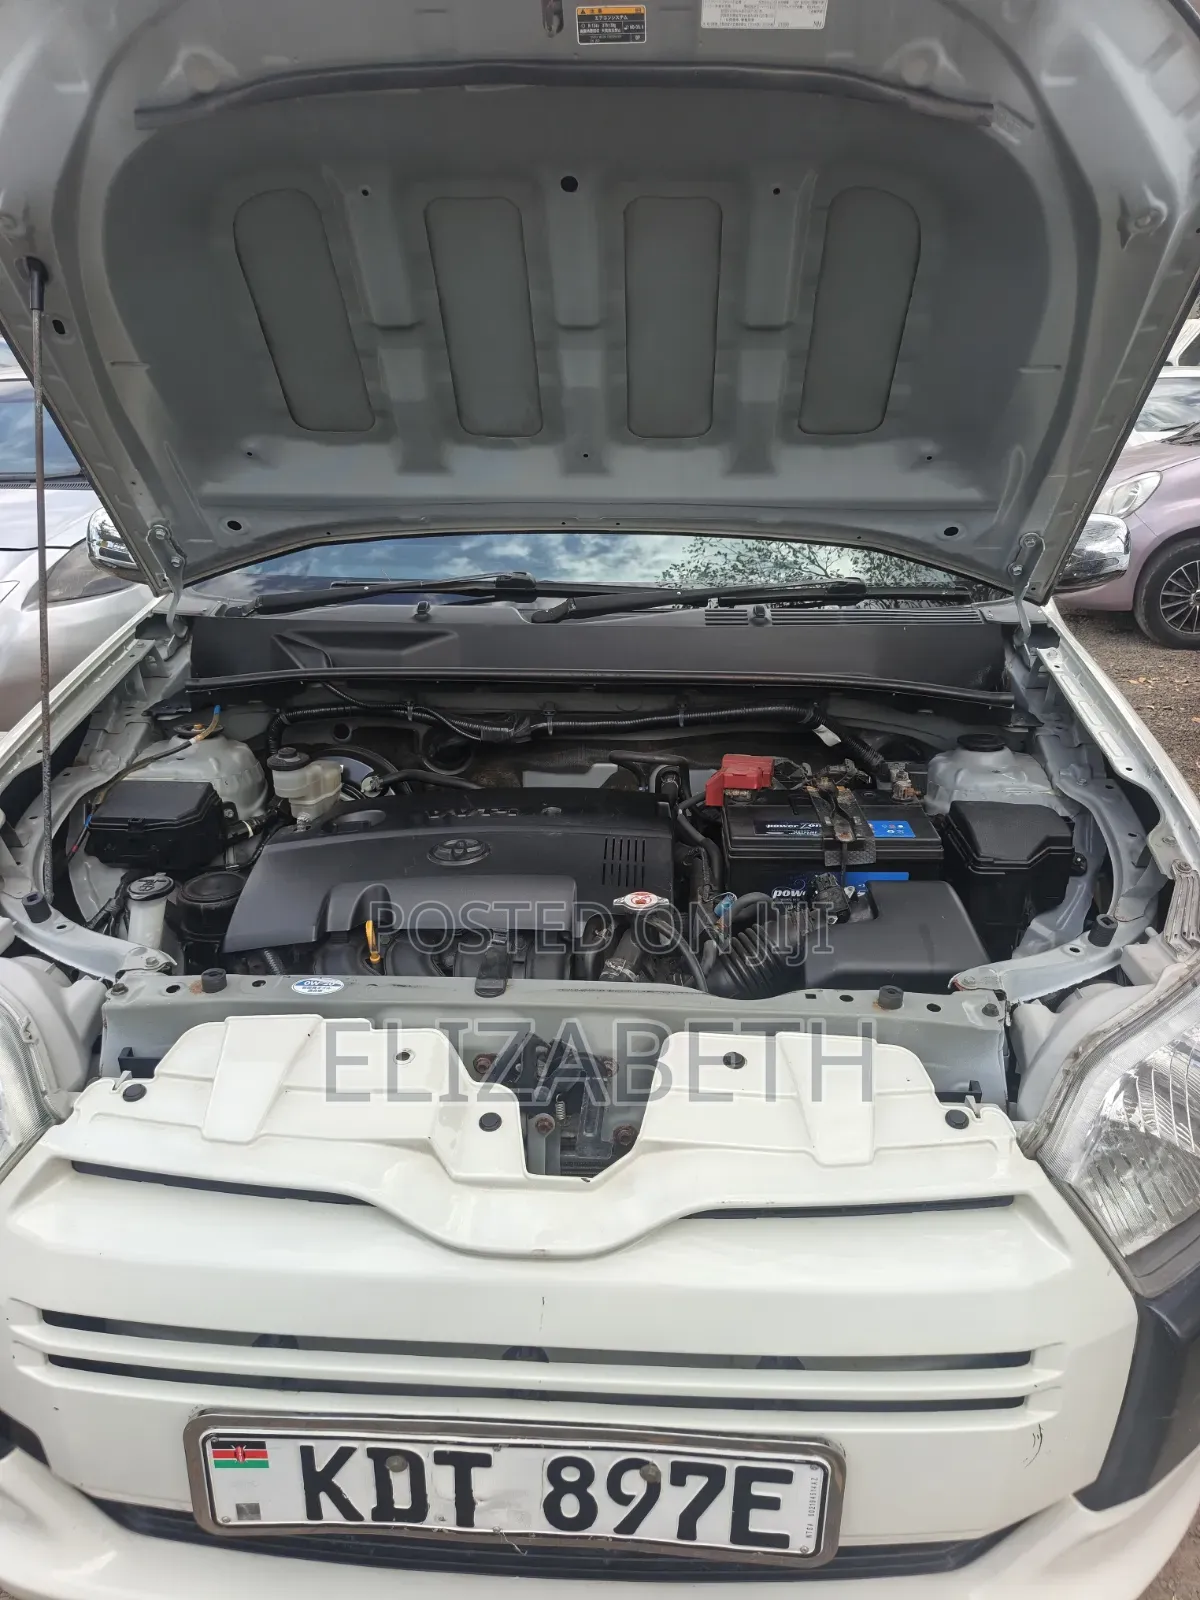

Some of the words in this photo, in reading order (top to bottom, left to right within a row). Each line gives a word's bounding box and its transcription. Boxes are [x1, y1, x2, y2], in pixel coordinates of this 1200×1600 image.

[772, 889, 806, 899] pow
[299, 1444, 493, 1528] KDT
[542, 1455, 797, 1549] 897E
